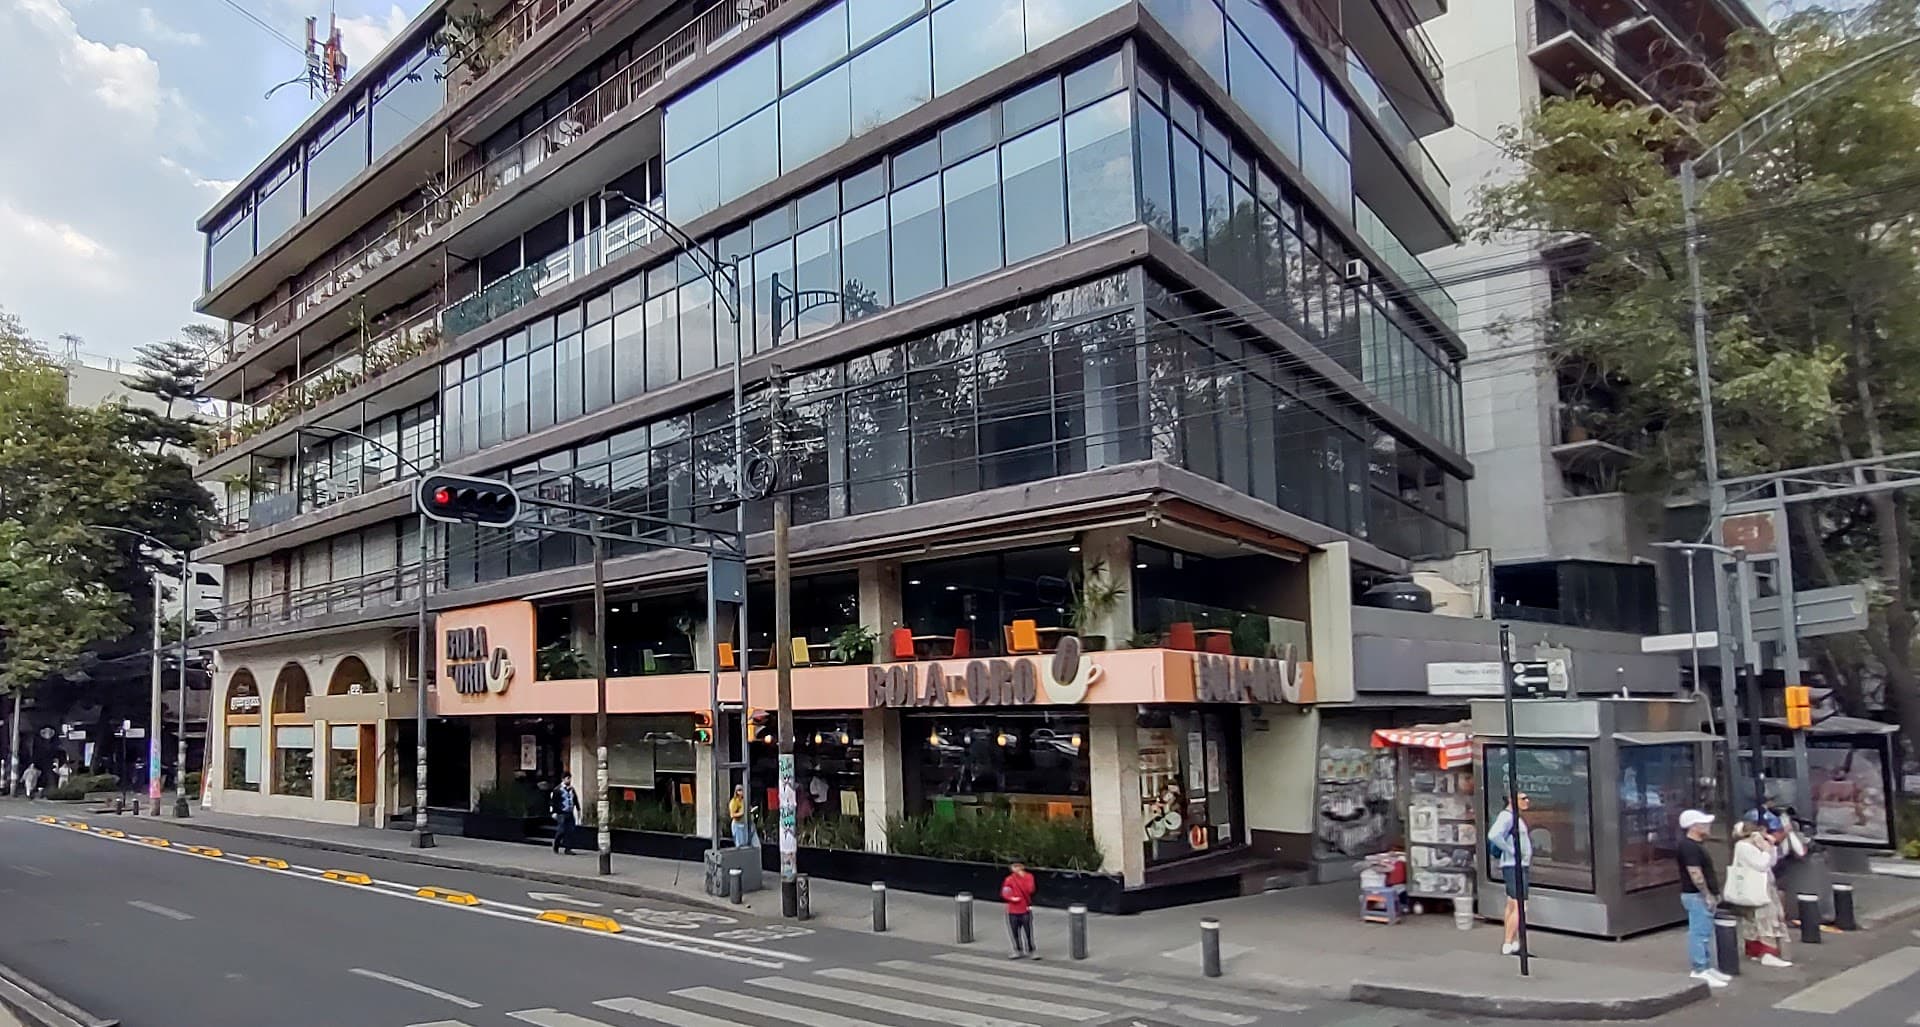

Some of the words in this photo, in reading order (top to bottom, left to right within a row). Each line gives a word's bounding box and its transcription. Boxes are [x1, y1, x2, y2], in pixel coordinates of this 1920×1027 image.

[446, 626, 488, 660] BOLA
[867, 662, 946, 706] BOLA
[966, 657, 1037, 705] ORO
